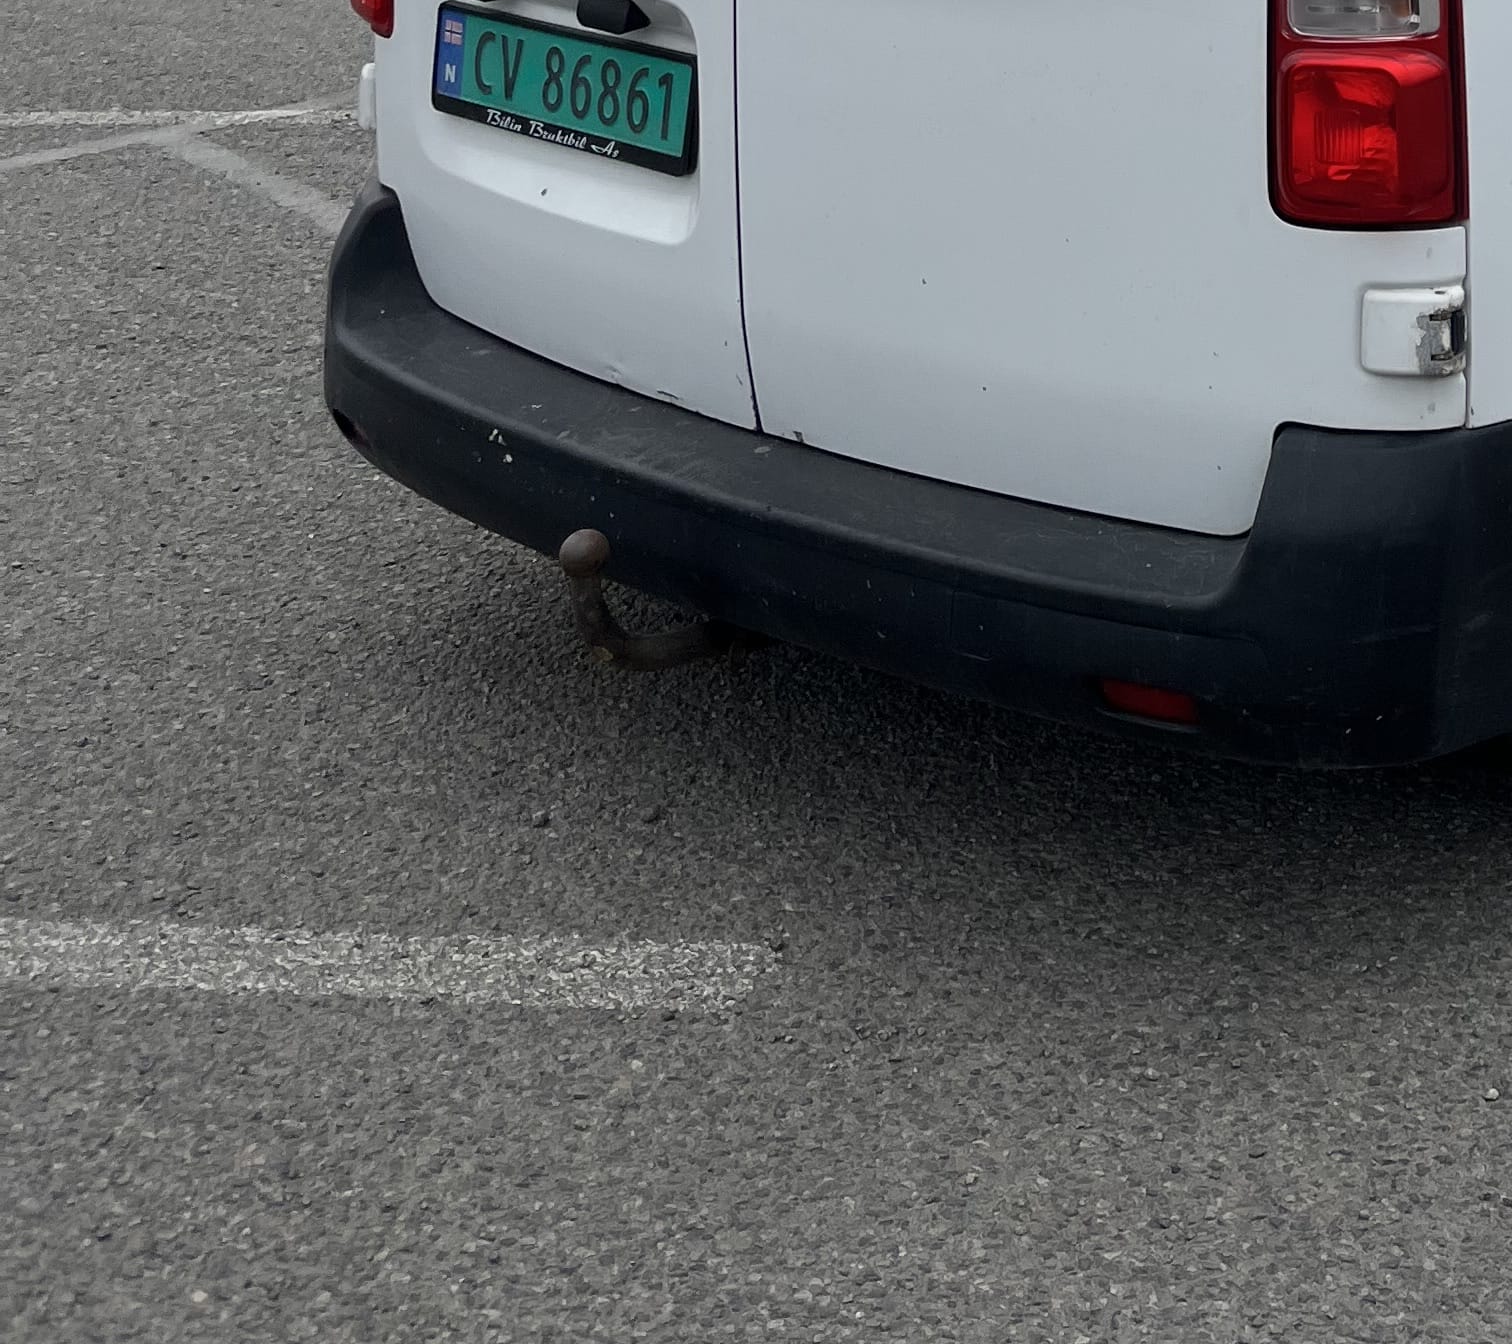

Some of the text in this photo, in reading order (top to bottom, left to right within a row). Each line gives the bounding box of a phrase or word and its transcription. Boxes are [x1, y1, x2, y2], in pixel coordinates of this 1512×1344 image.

[444, 63, 456, 83] N
[474, 30, 674, 141] CV 86861
[486, 108, 522, 132] Bilin
[528, 120, 588, 149] Bruktbil
